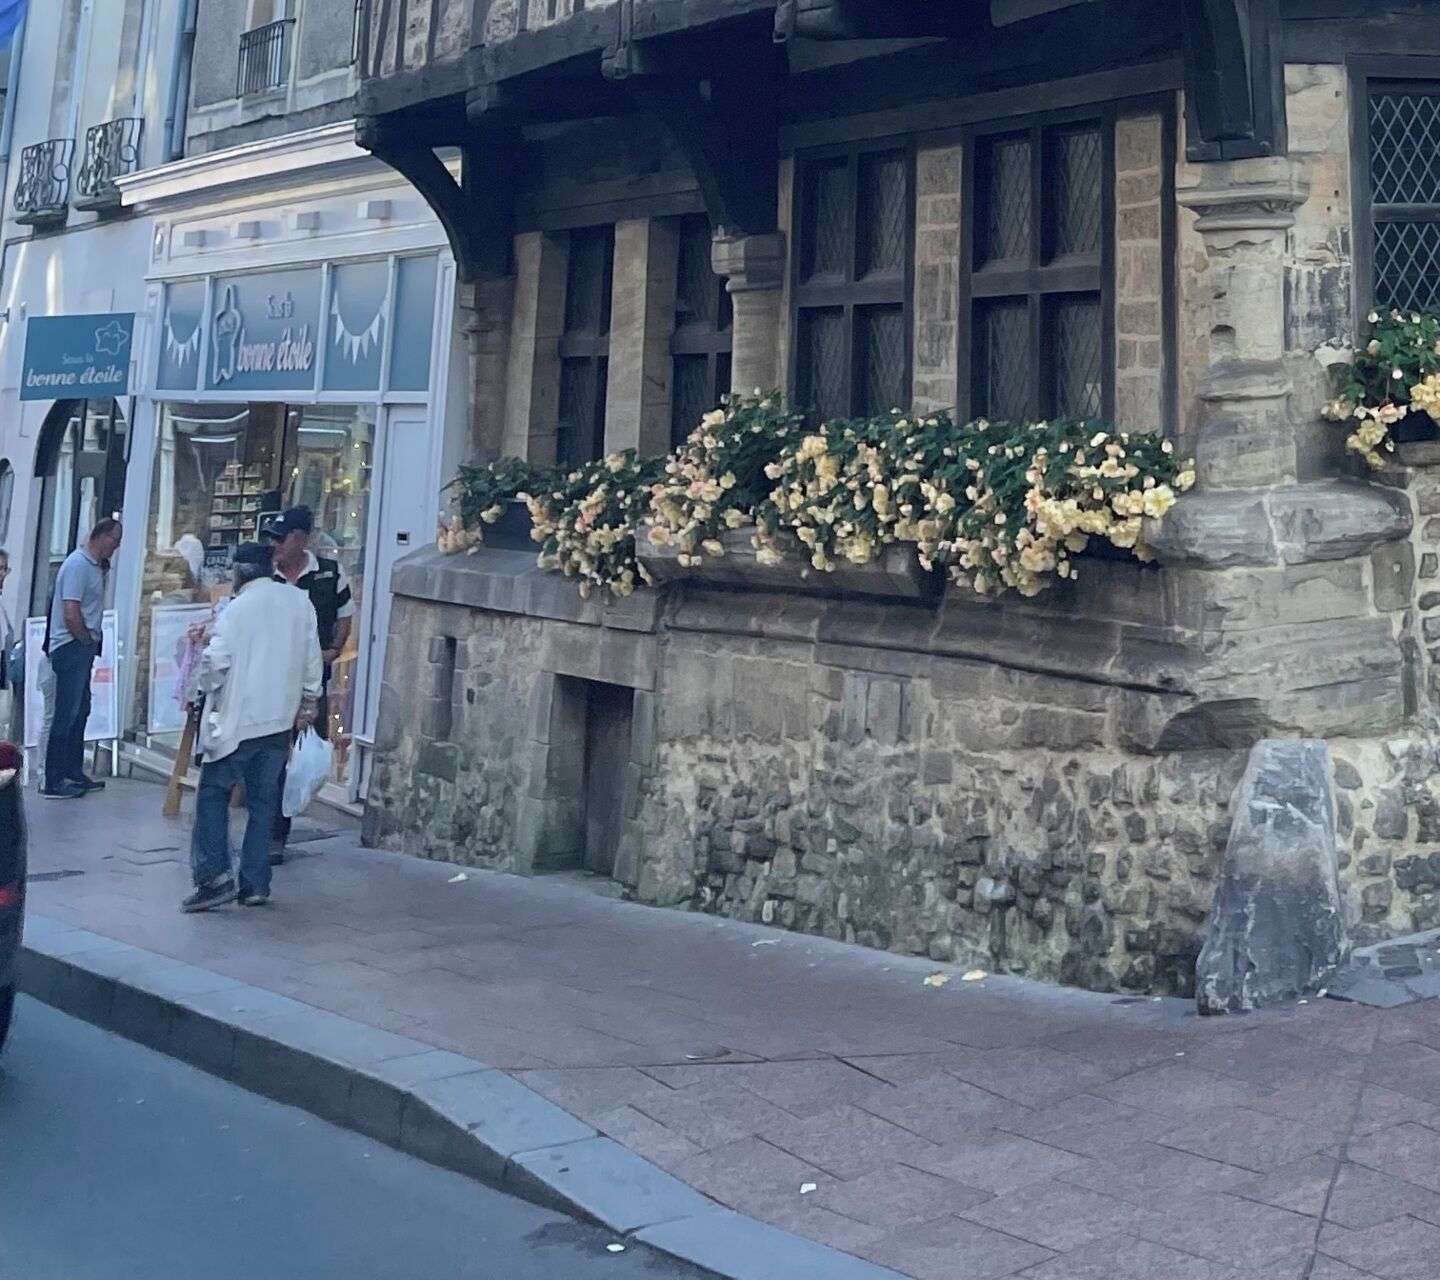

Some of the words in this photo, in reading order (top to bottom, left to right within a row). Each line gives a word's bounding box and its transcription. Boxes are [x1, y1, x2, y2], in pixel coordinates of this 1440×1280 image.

[237, 327, 275, 372] bonne
[276, 323, 313, 371] étoile
[26, 368, 77, 387] bonne
[79, 364, 123, 385] étoile
